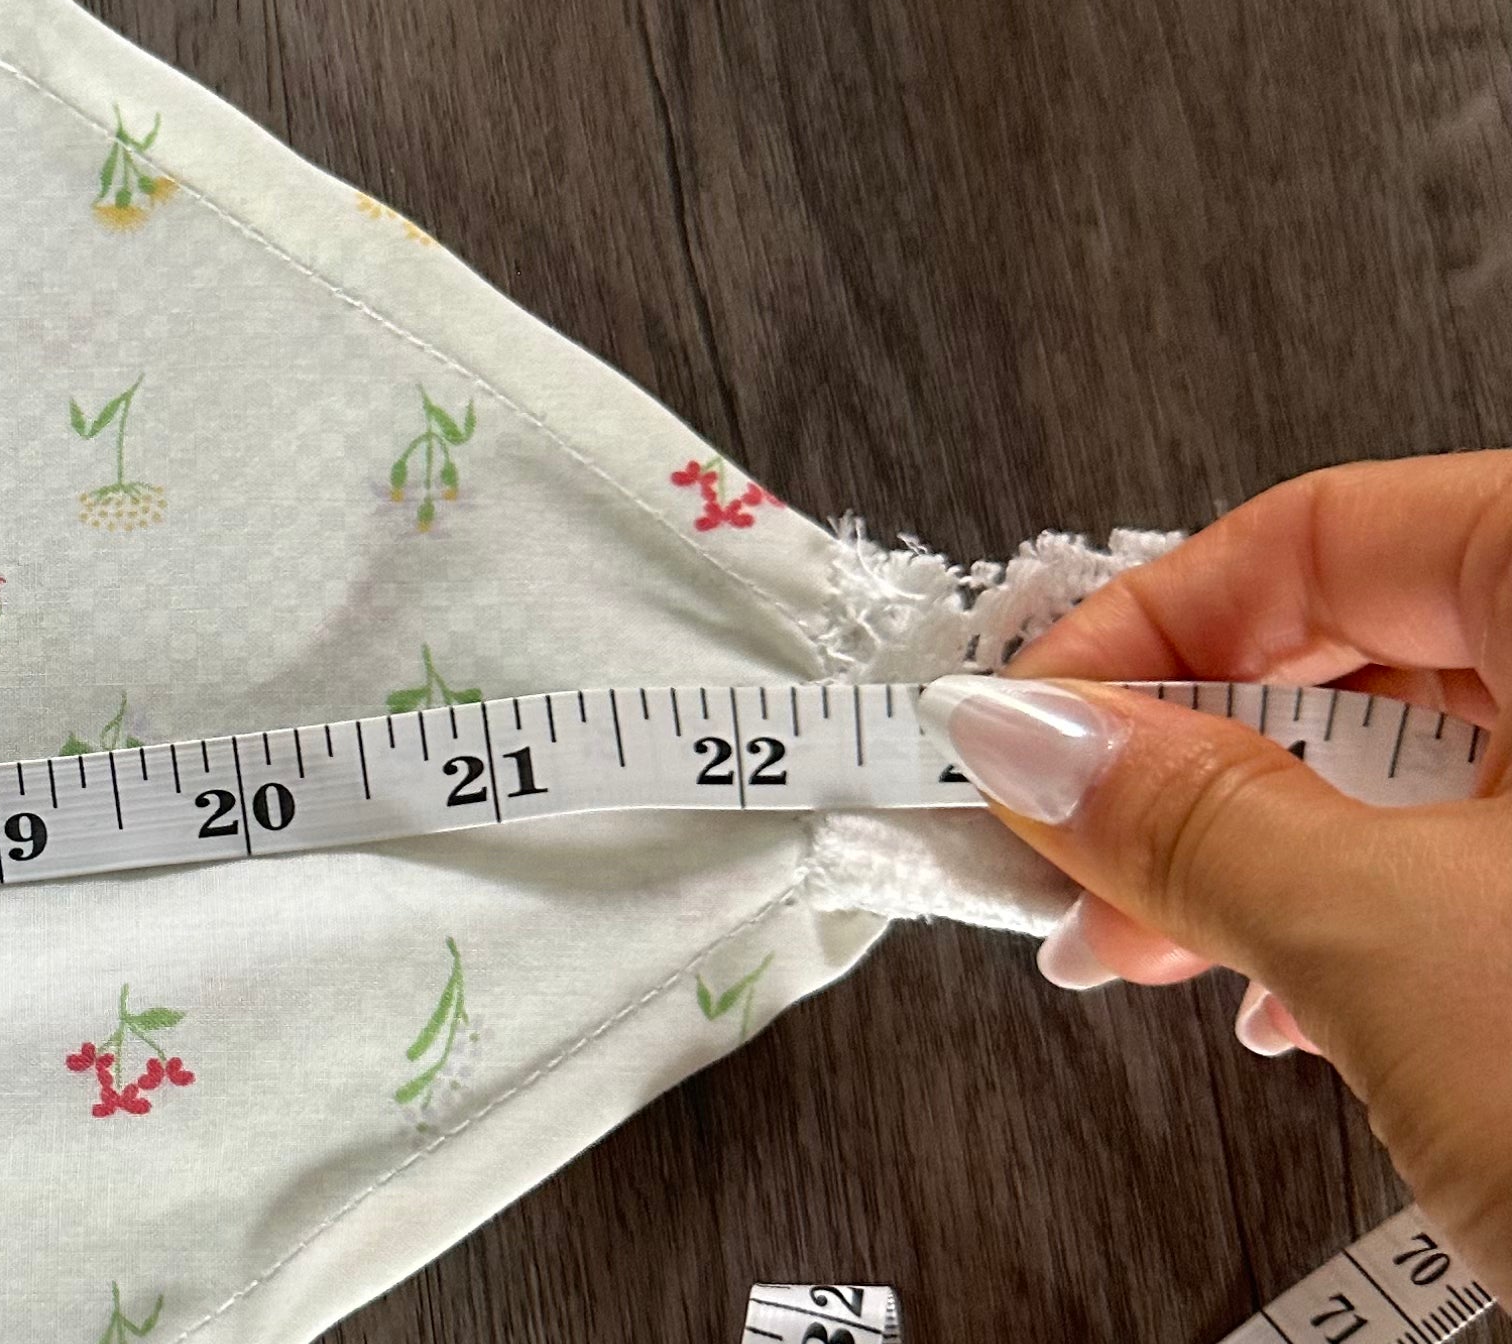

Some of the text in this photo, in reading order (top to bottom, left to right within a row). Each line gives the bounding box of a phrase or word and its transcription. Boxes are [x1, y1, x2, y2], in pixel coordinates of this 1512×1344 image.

[442, 745, 548, 807] 21
[693, 736, 787, 785] 22
[194, 782, 295, 838] 20
[1393, 1232, 1451, 1286] 70
